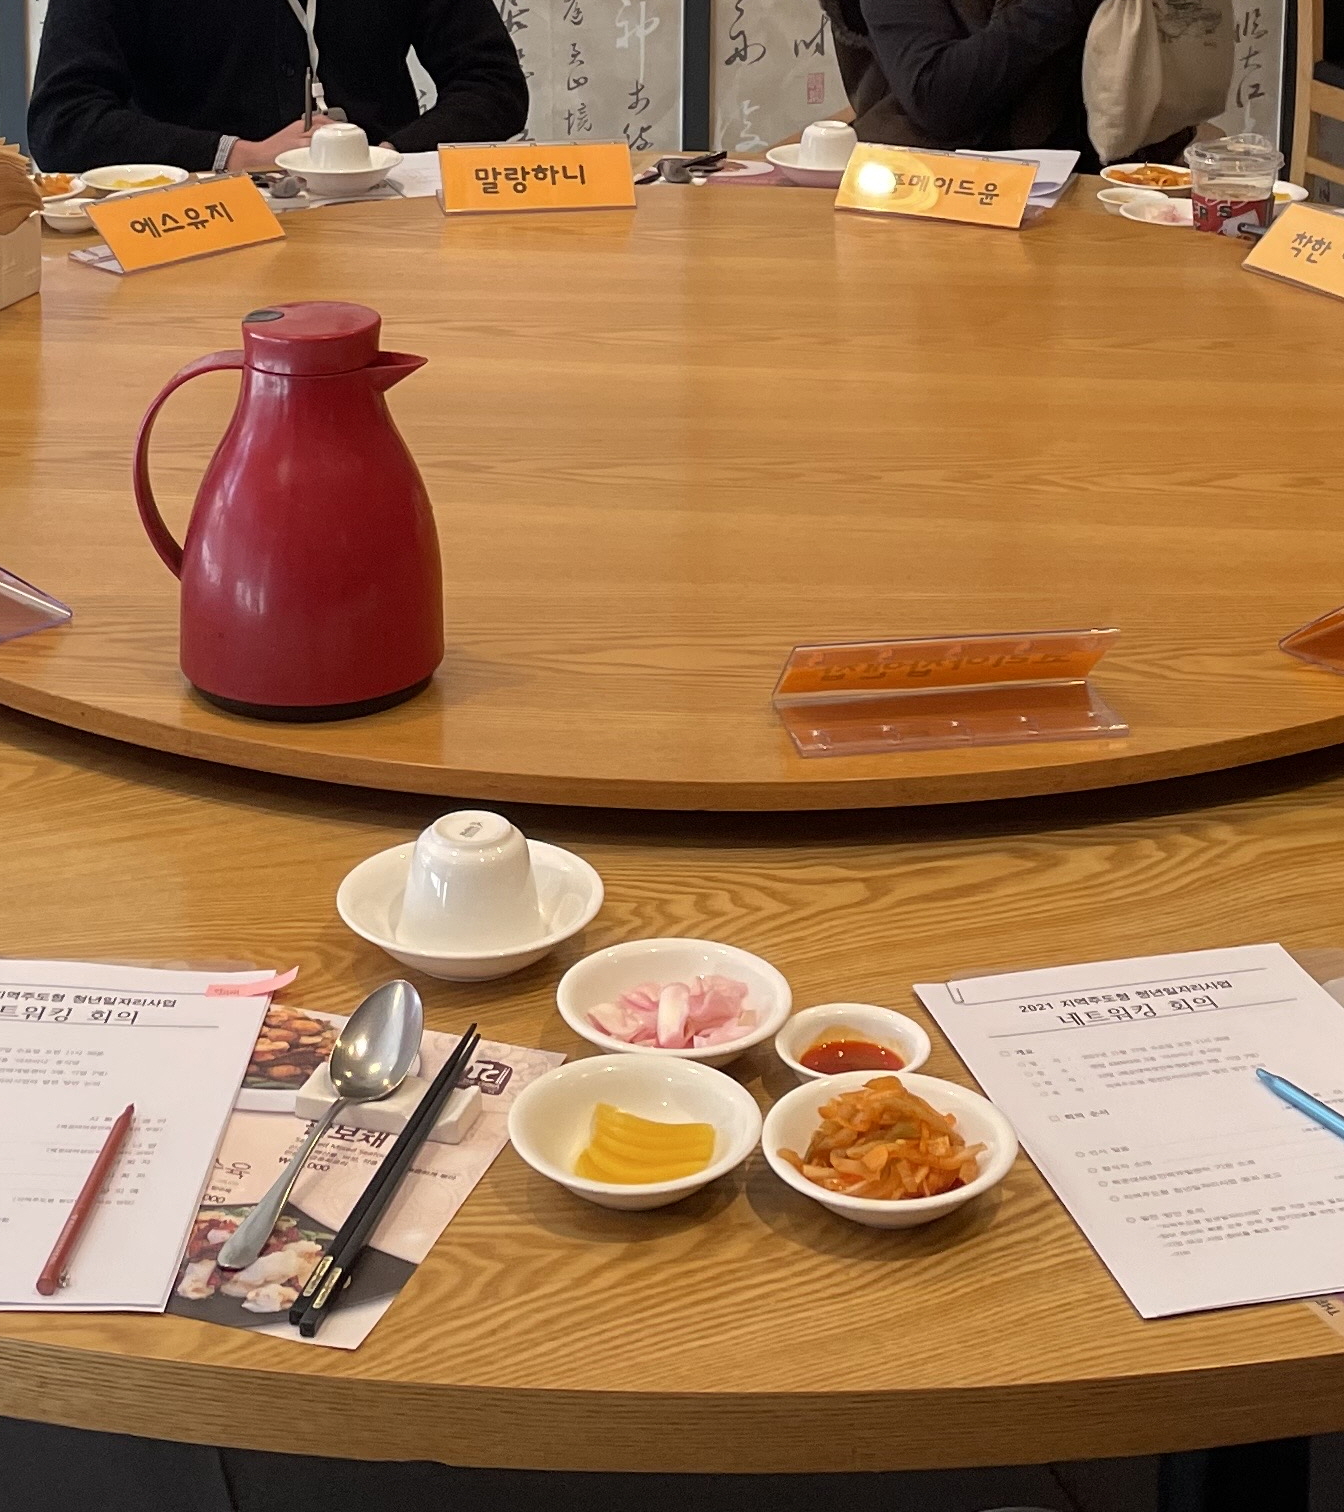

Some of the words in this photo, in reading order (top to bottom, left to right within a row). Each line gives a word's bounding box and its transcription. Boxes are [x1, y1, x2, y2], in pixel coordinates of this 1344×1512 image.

[474, 164, 587, 194] 말랑하니
[130, 201, 234, 240] 에스유지
[1290, 231, 1332, 264] 착한
[87, 1009, 139, 1025] 회의
[1019, 1002, 1055, 1013] 2021
[1057, 1003, 1158, 1025] 네트워킹
[1168, 995, 1219, 1012] 회의
